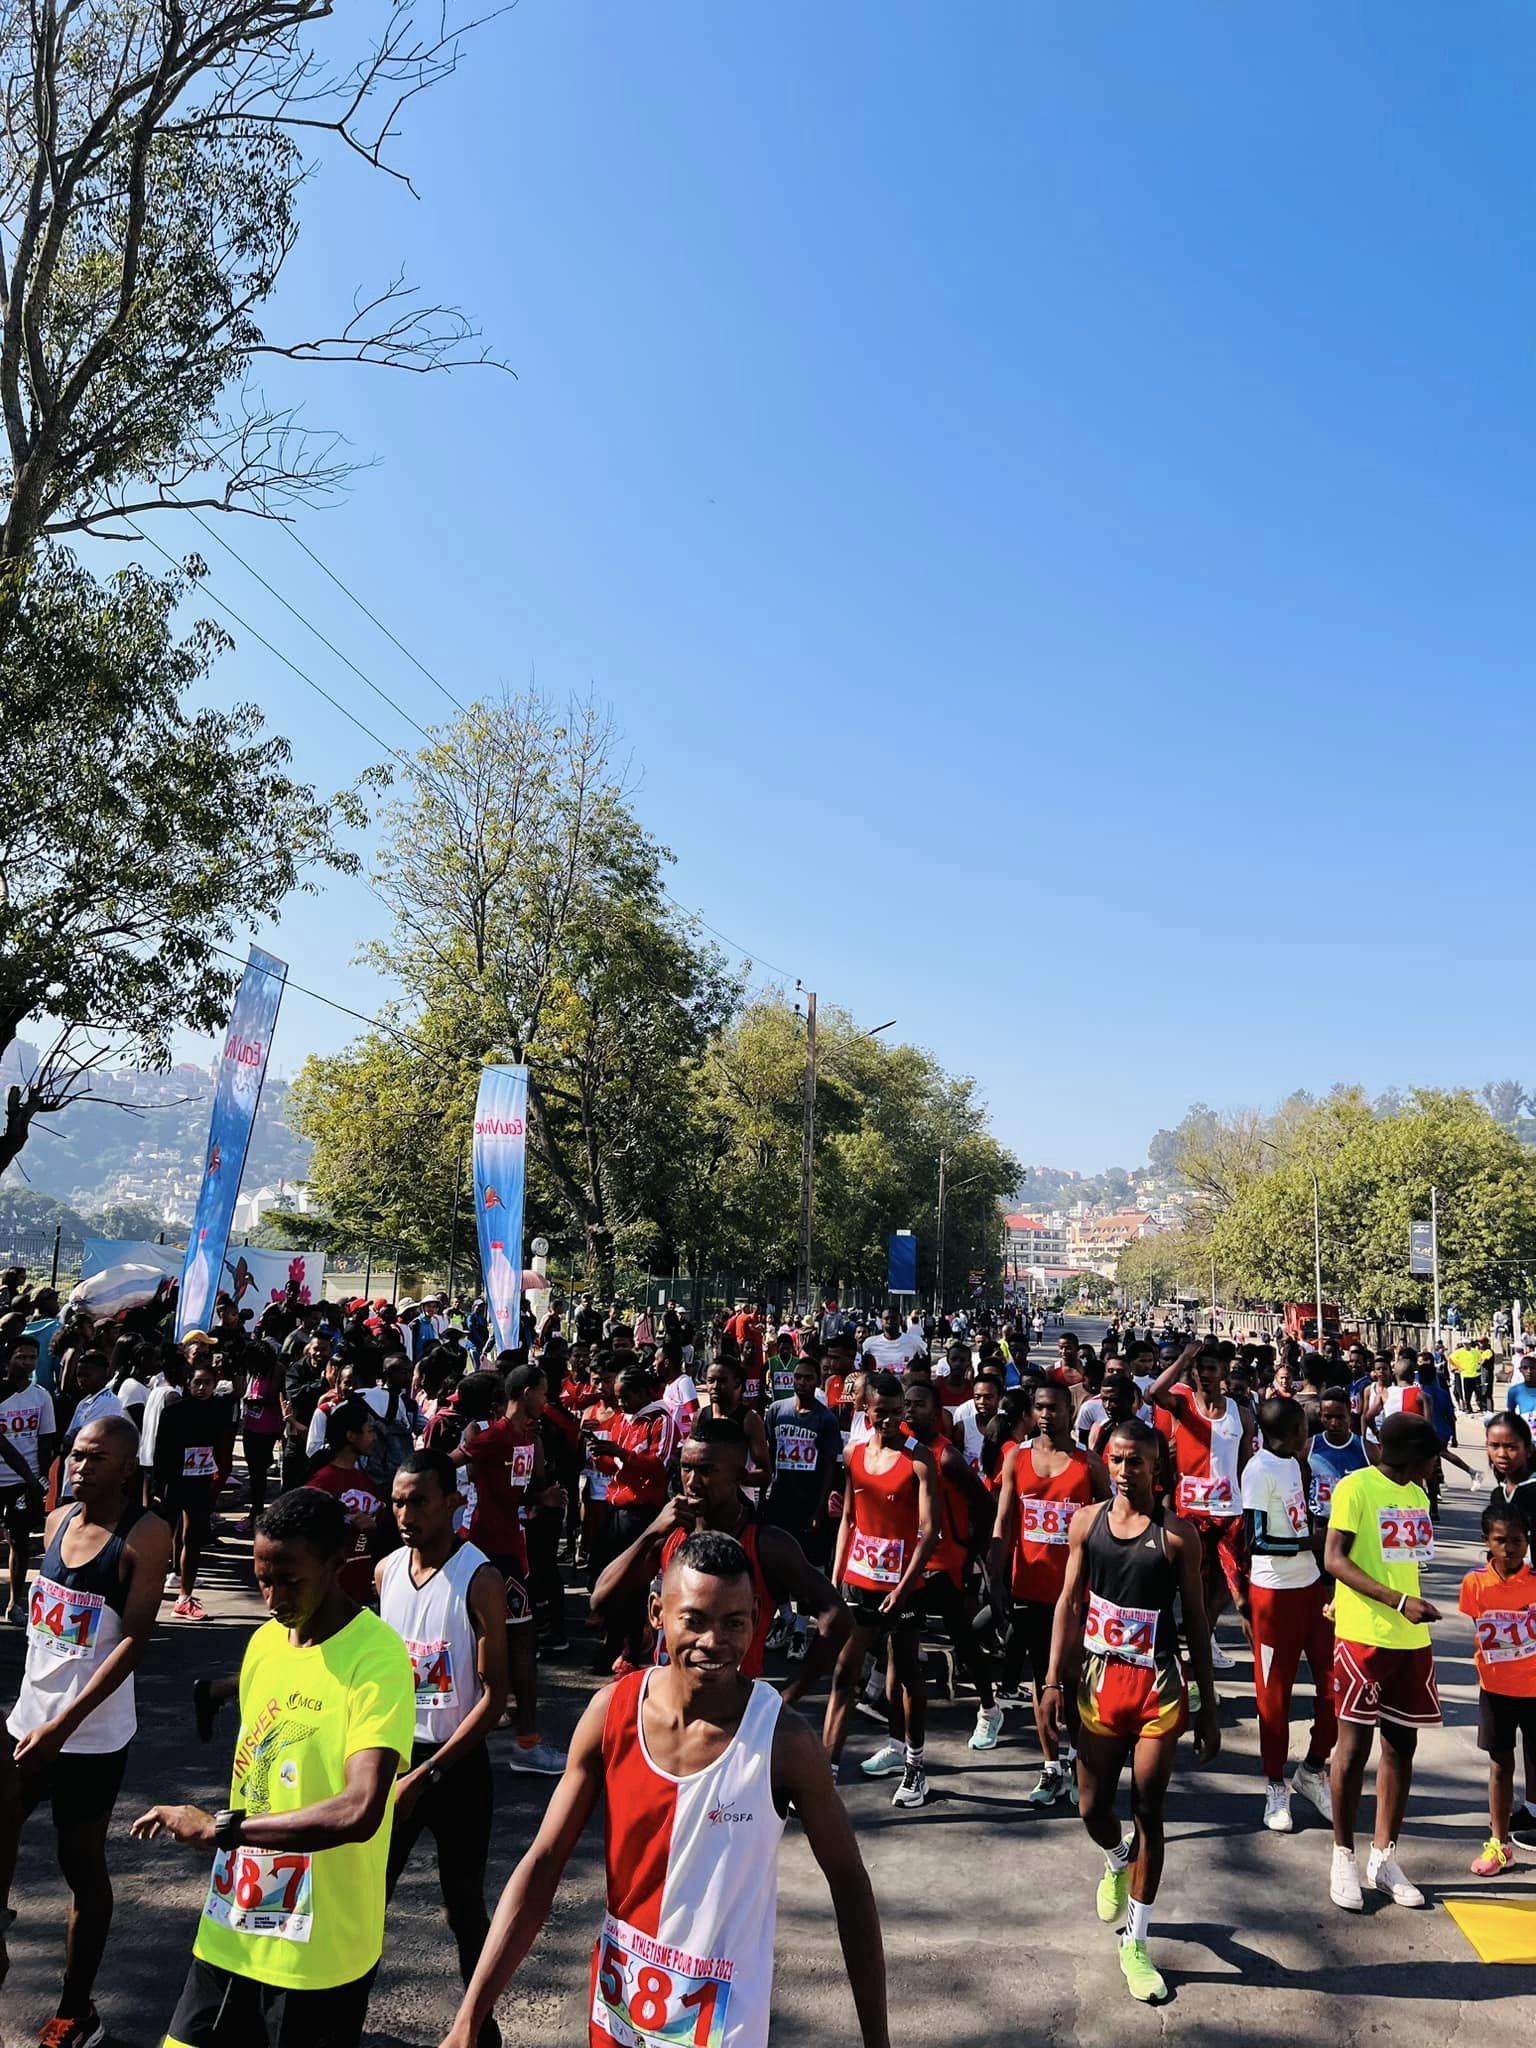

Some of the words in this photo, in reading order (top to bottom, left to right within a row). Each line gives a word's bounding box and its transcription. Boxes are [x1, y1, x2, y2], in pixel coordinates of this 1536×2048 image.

[1183, 1480, 1233, 1503] 572
[853, 1539, 900, 1573] 568
[1381, 1520, 1433, 1548] 233
[31, 1591, 93, 1646] 641
[1087, 1607, 1153, 1654] 564
[298, 1696, 323, 1712] MCB
[233, 1697, 282, 1780] INISHER
[723, 1812, 753, 1823] OSFA
[214, 1850, 310, 1912] 387
[631, 1933, 673, 1968] ATHLETISME
[673, 1949, 693, 1977] POUR
[694, 1957, 714, 1978] TOUS
[714, 1958, 735, 1982] 2023
[599, 1940, 720, 2048] 581
